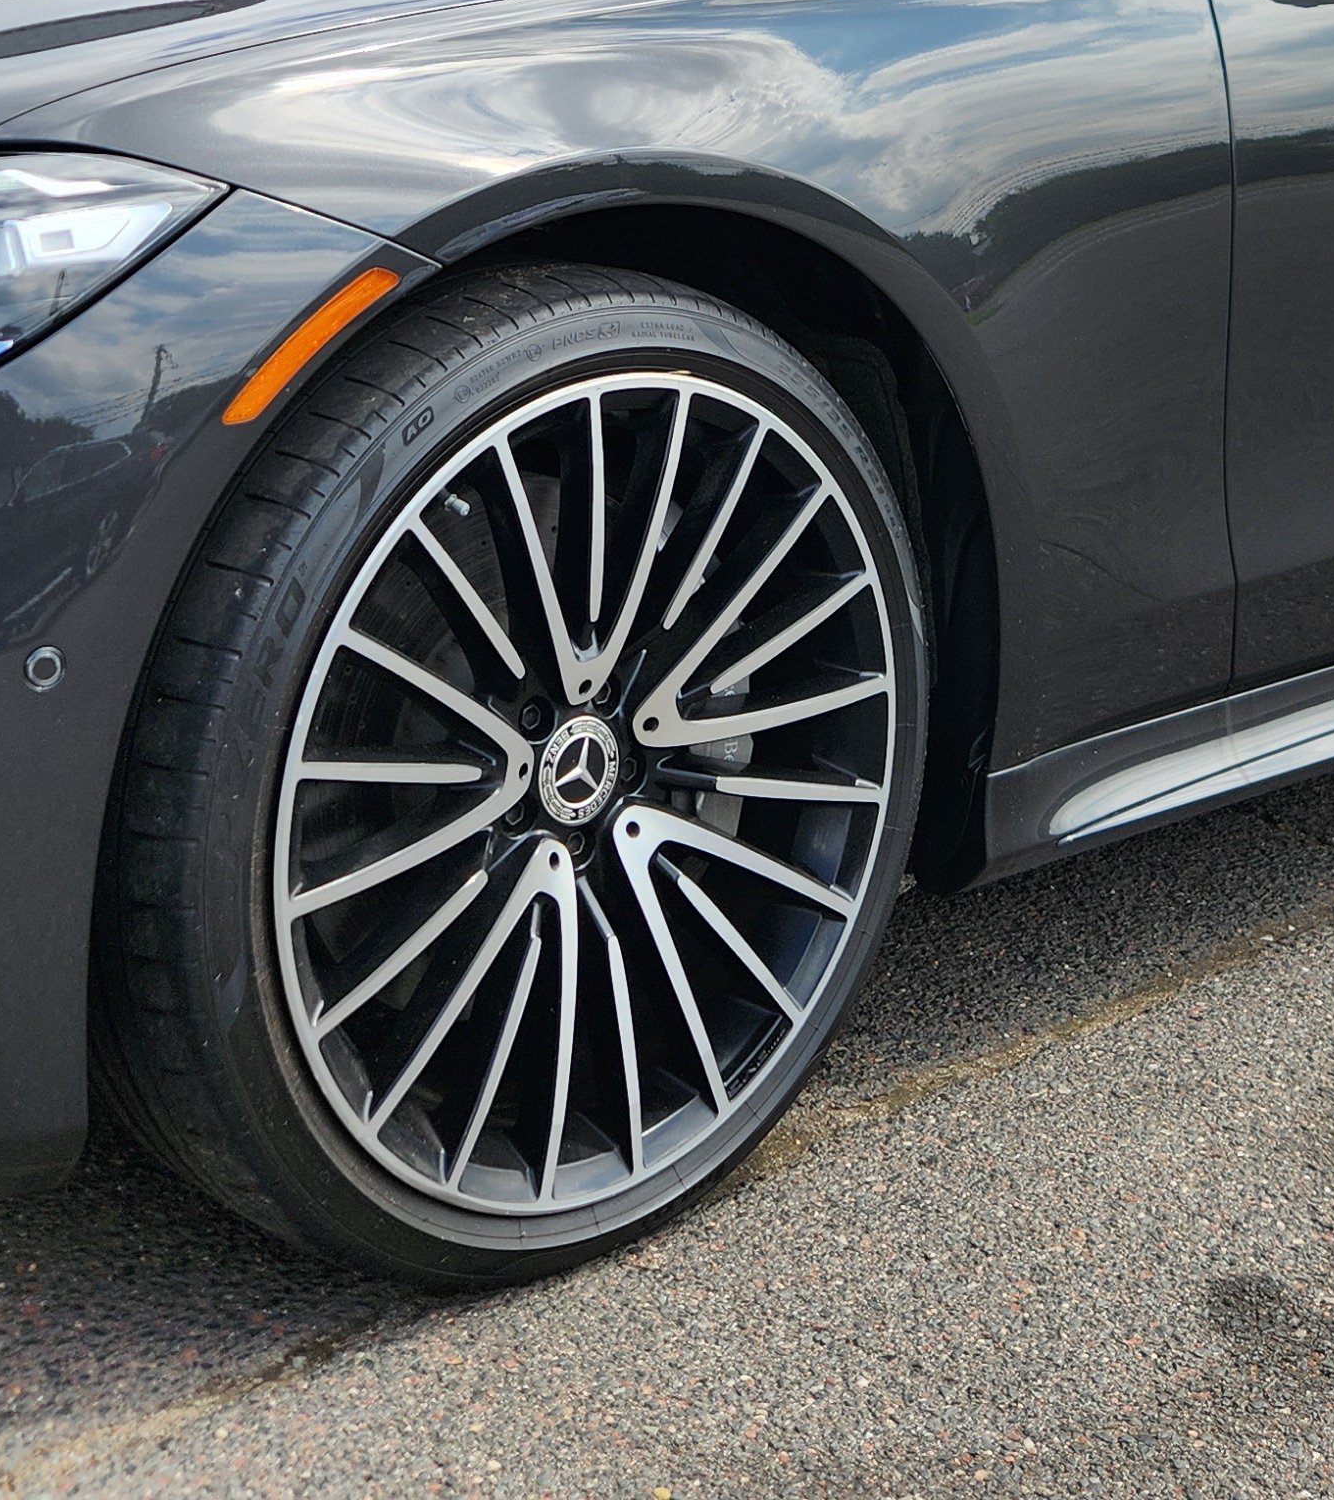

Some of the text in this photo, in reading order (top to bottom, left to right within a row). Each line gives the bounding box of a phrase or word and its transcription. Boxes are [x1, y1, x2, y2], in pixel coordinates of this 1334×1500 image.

[406, 409, 431, 442] AO
[547, 728, 571, 764] BENZ
[578, 761, 616, 819] MERCEDES
